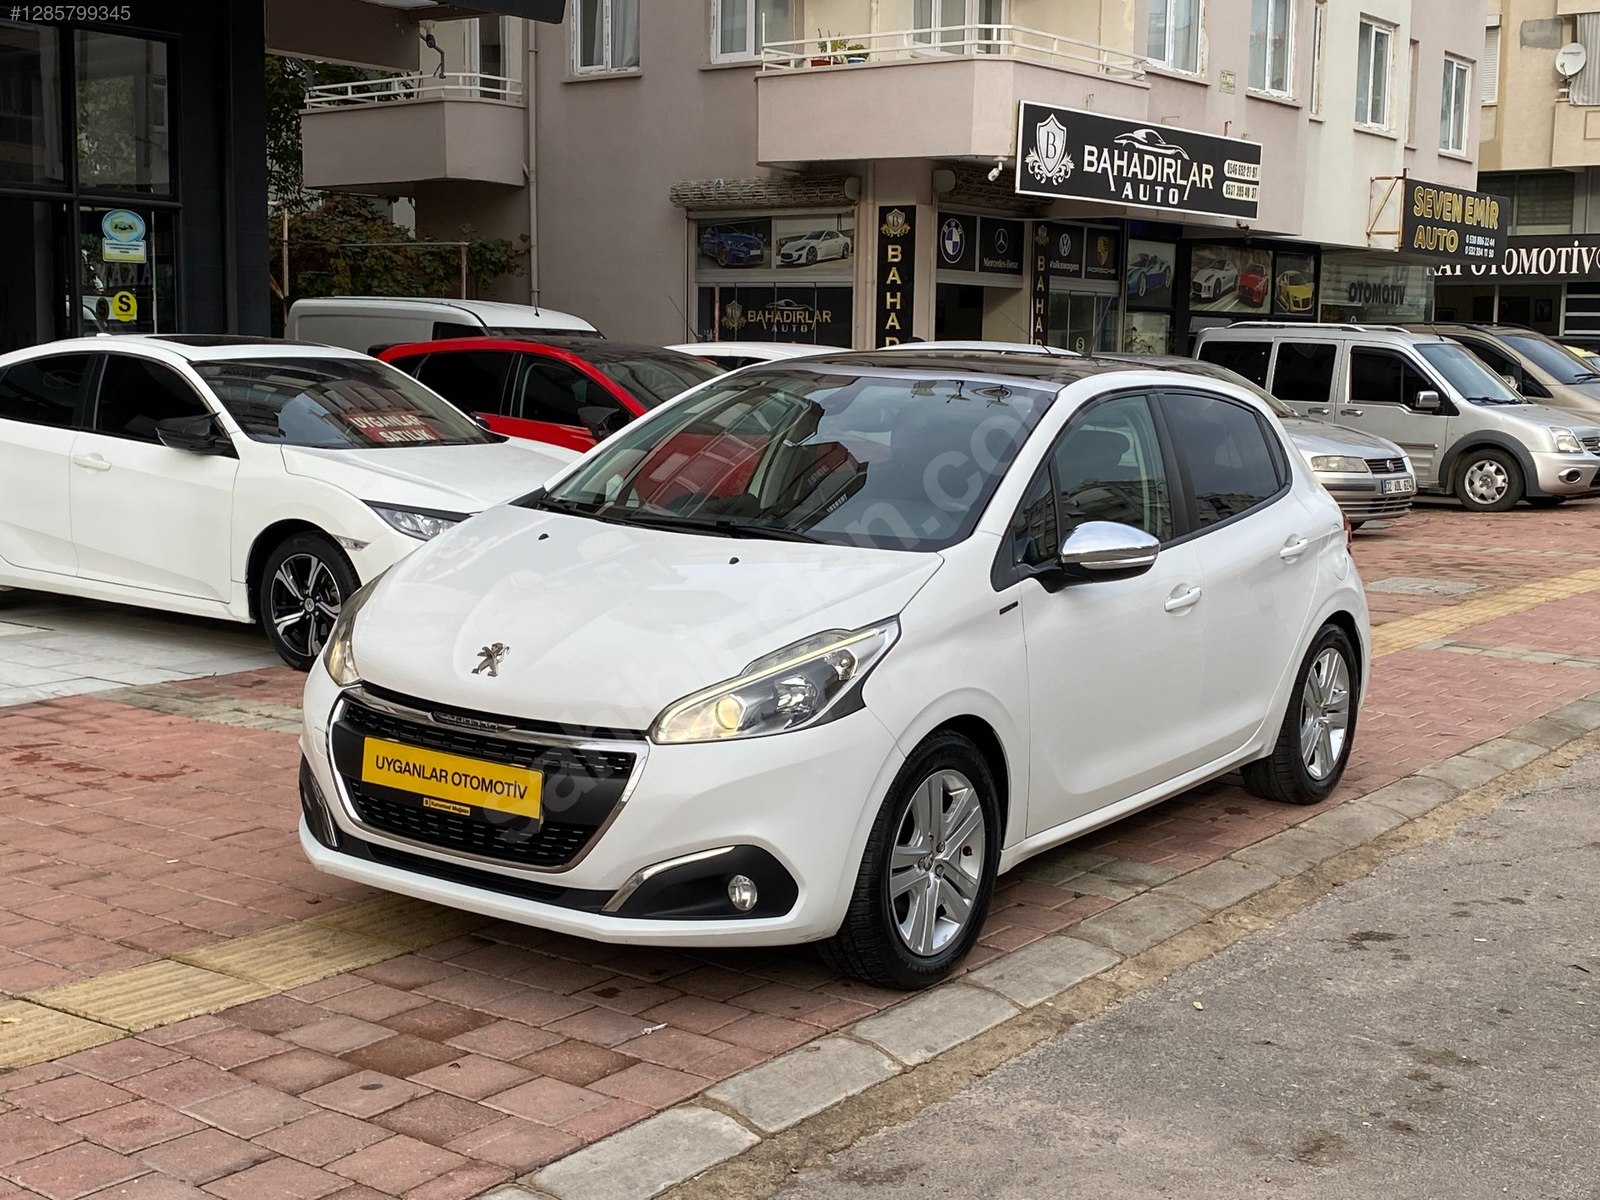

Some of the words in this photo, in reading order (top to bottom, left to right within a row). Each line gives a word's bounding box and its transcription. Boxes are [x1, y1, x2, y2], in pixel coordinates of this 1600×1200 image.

[1083, 144, 1214, 200] BAHADIRLAR
[1122, 182, 1179, 205] AUTO
[1413, 185, 1463, 223] SEVEN
[1464, 196, 1500, 230] EMİR
[1413, 225, 1459, 253] AUTO
[118, 294, 131, 313] S
[747, 310, 832, 330] BAHADIRLAR
[771, 324, 808, 333] AUTO
[380, 429, 436, 442] SATILIK
[375, 755, 448, 784] UYGANLAR
[451, 772, 528, 800] OTOMOTİV
